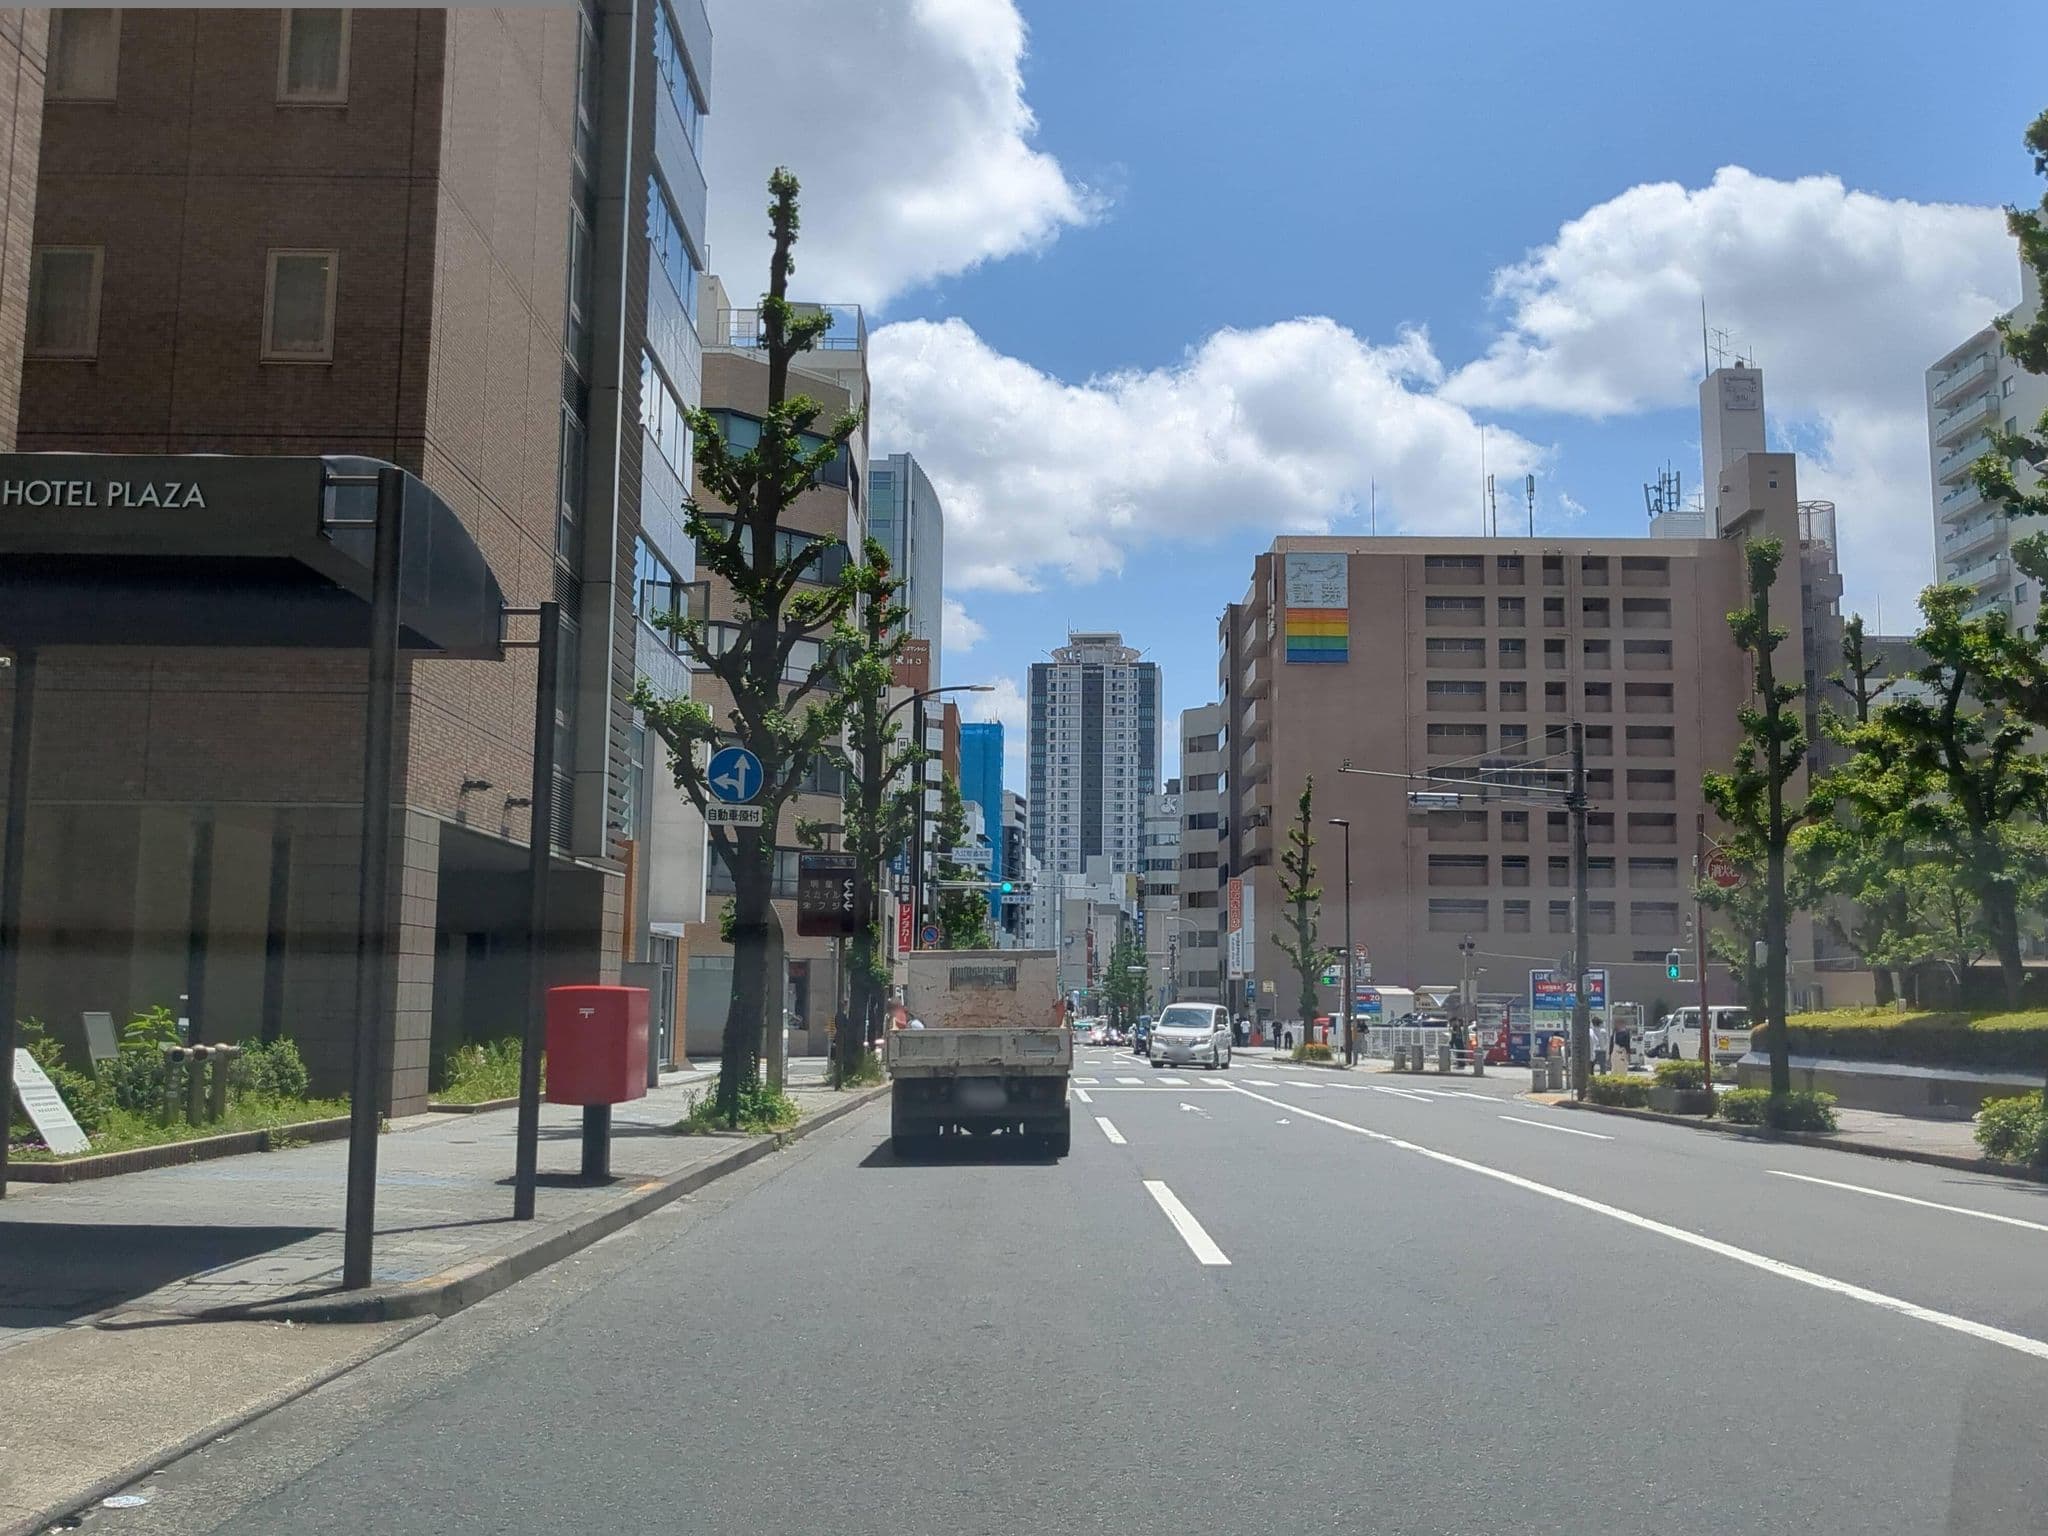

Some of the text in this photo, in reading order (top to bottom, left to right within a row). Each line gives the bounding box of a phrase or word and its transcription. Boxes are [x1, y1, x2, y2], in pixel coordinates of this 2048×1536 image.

[3, 481, 207, 509] HOTEL PLAZA
[707, 808, 760, 823] 自動車原付
[901, 905, 911, 943] レンタカー
[1328, 967, 1336, 975] P
